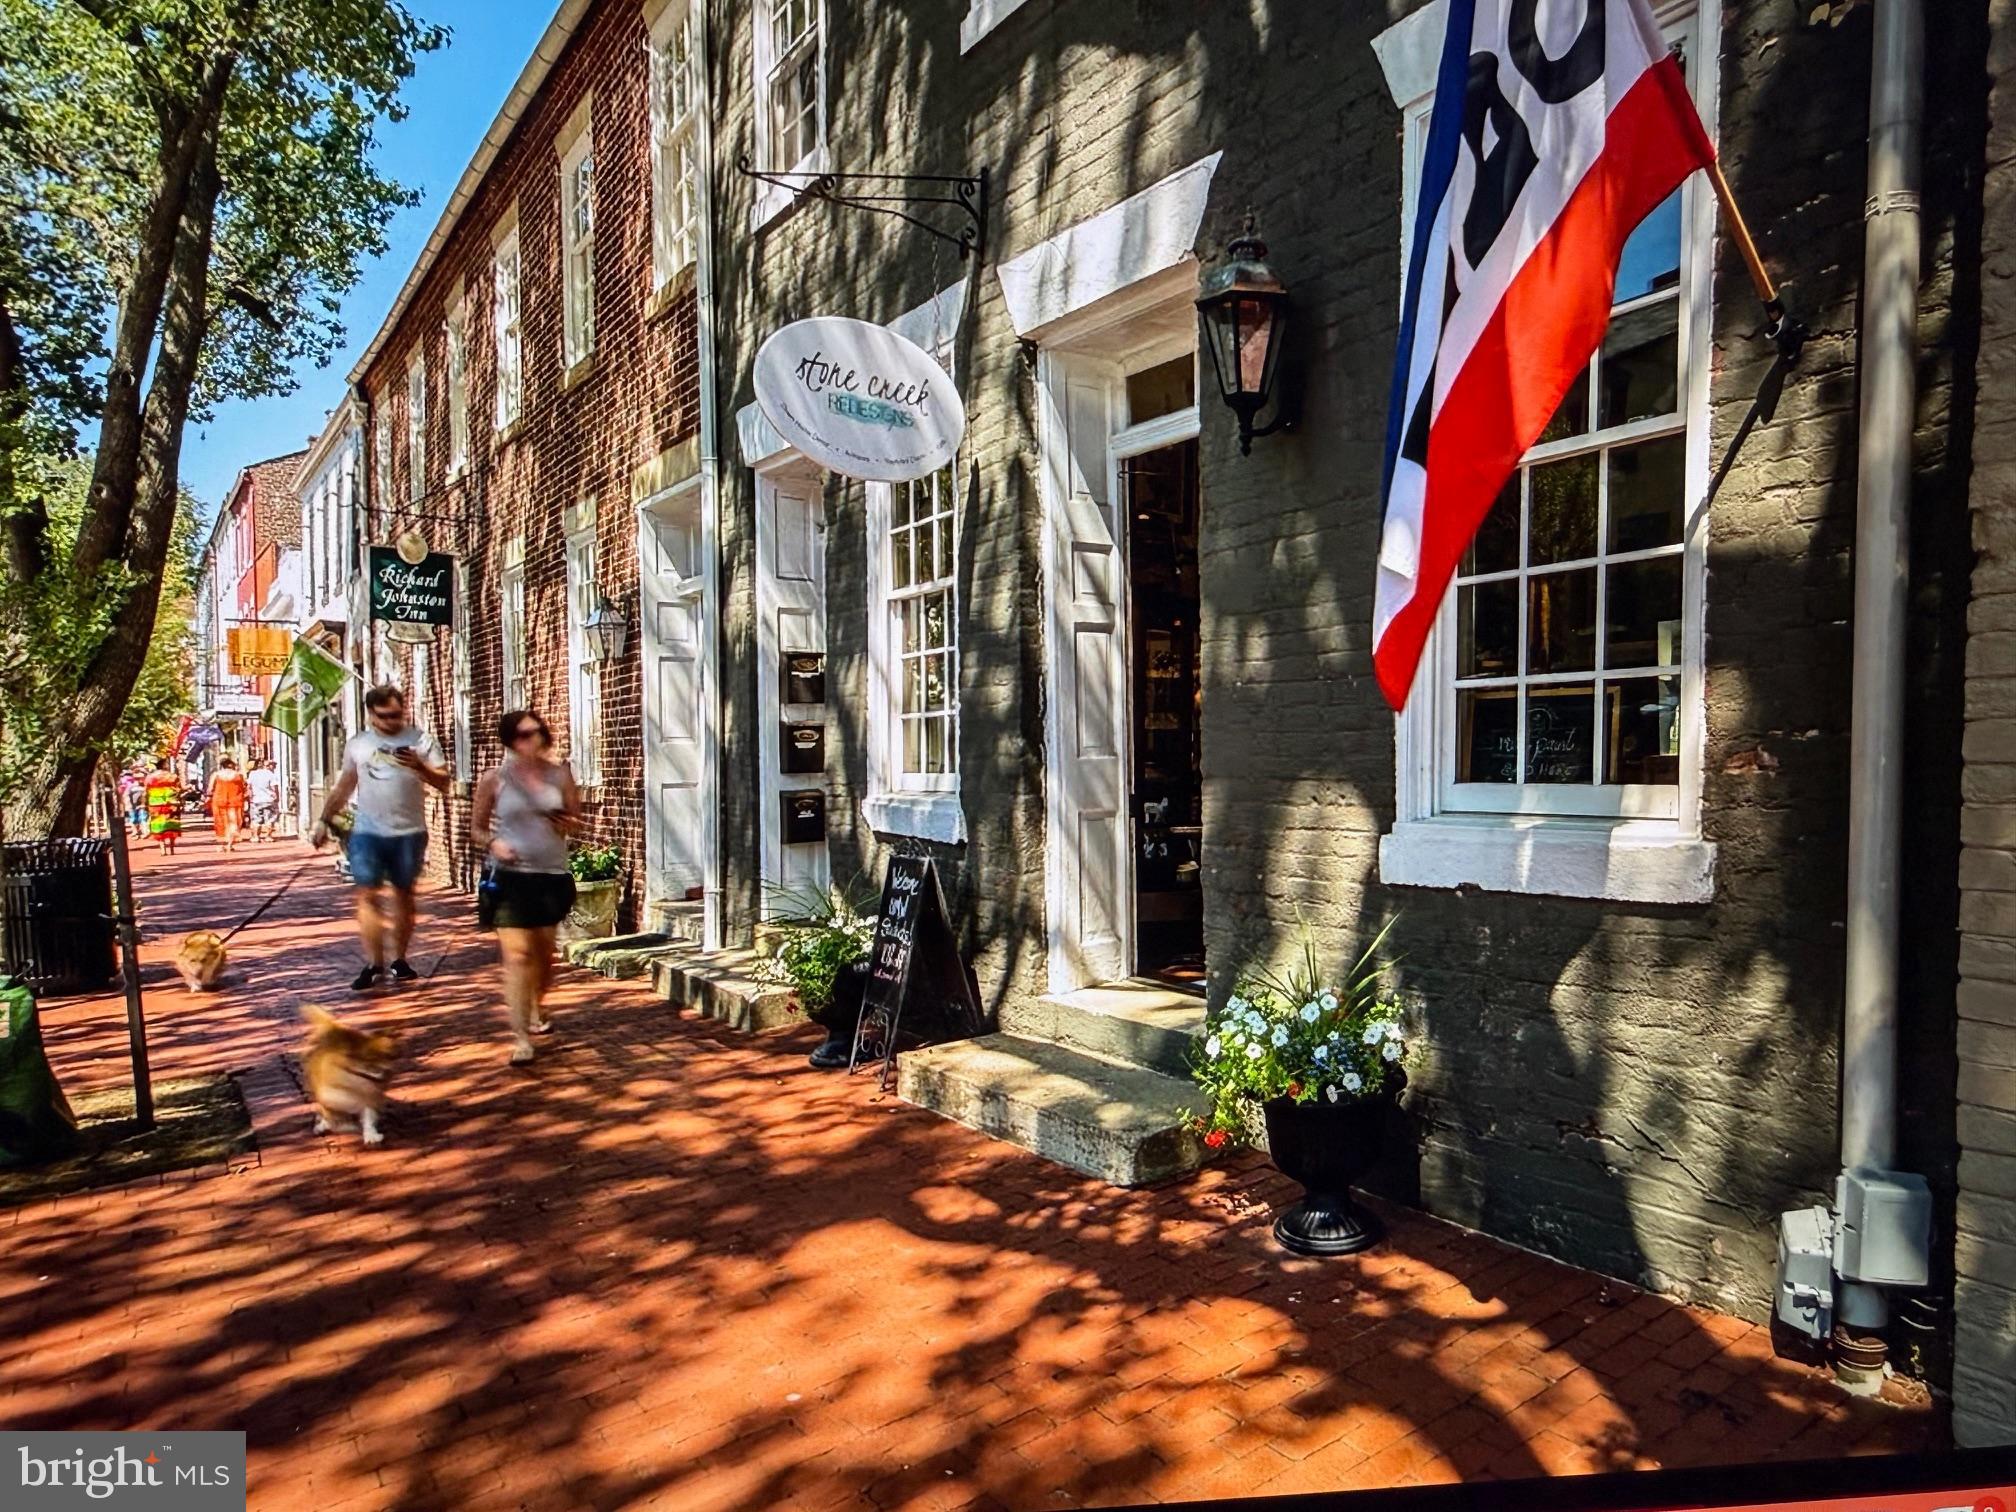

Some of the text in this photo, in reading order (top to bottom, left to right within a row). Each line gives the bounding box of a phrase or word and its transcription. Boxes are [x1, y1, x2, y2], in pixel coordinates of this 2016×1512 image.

[795, 352, 929, 417] stone creek
[379, 563, 446, 589] Richard
[375, 587, 447, 610] Johnston
[394, 604, 428, 620] Inn
